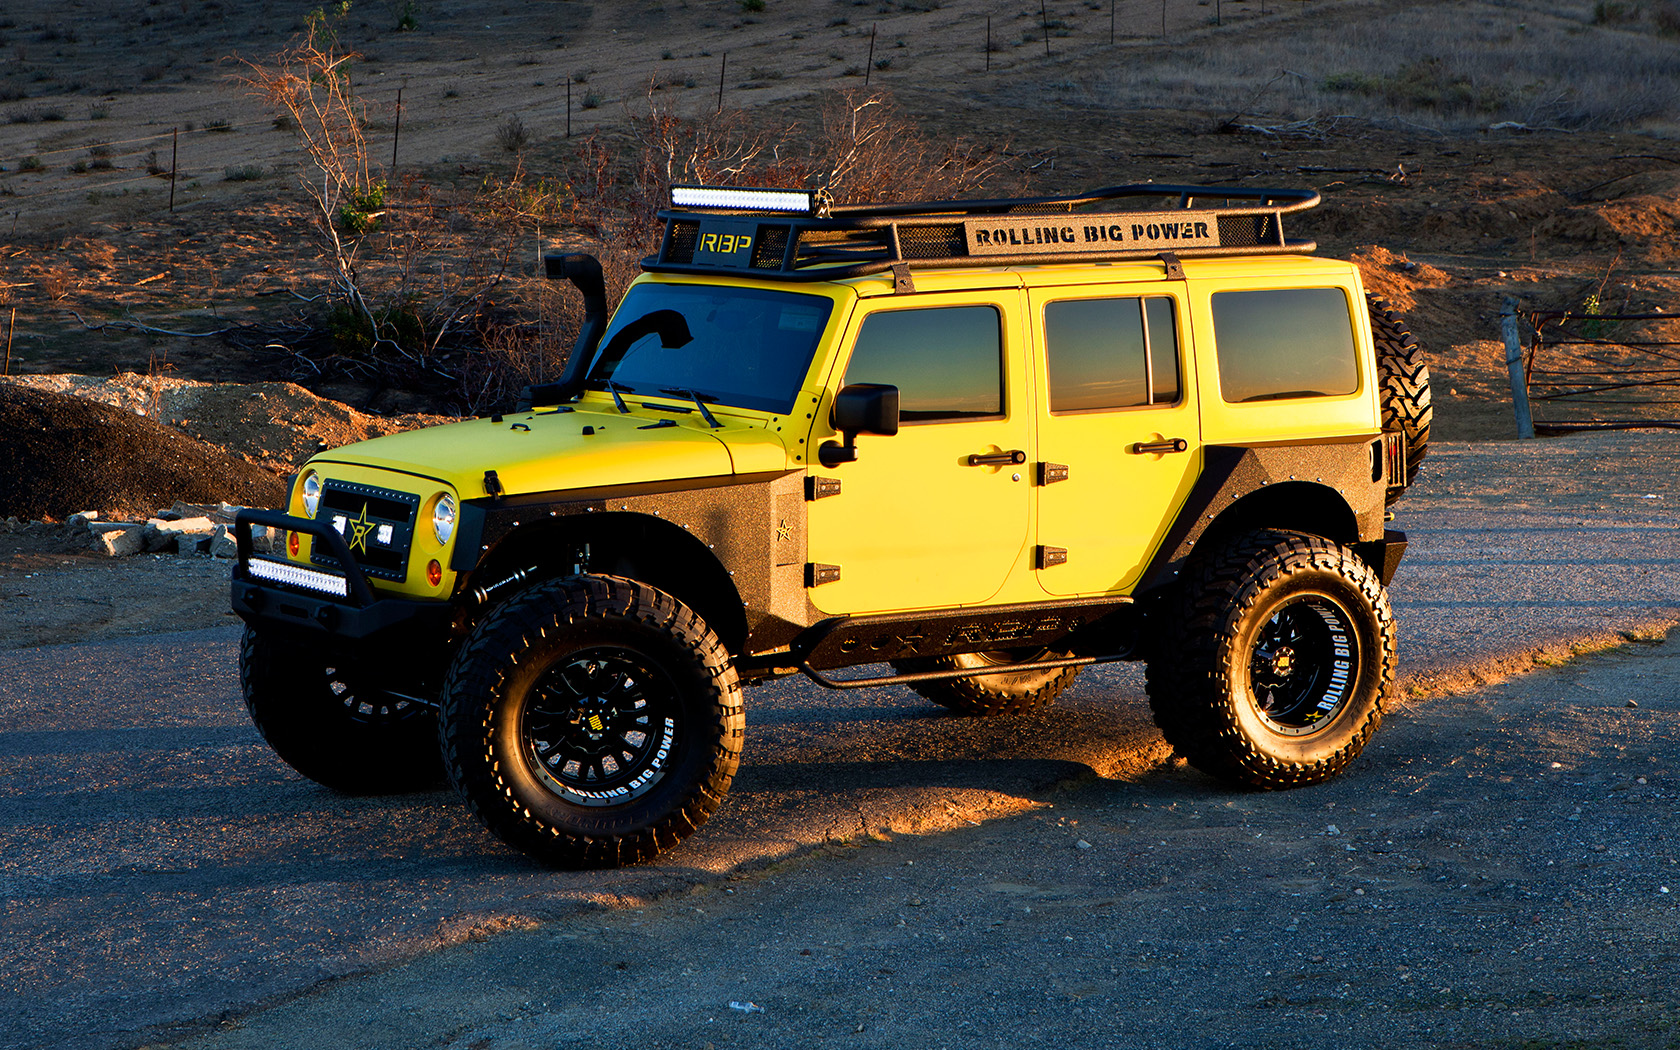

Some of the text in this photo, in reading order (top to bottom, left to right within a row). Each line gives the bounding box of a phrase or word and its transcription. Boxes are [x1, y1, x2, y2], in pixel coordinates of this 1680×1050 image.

[699, 233, 752, 254] RBP
[975, 221, 1210, 247] ROLLING BIG POWER
[943, 614, 1064, 647] RBP
[1331, 634, 1350, 657] BIG
[1316, 660, 1350, 711] ROLLING
[566, 717, 675, 799] ROLLING BIG POWER
